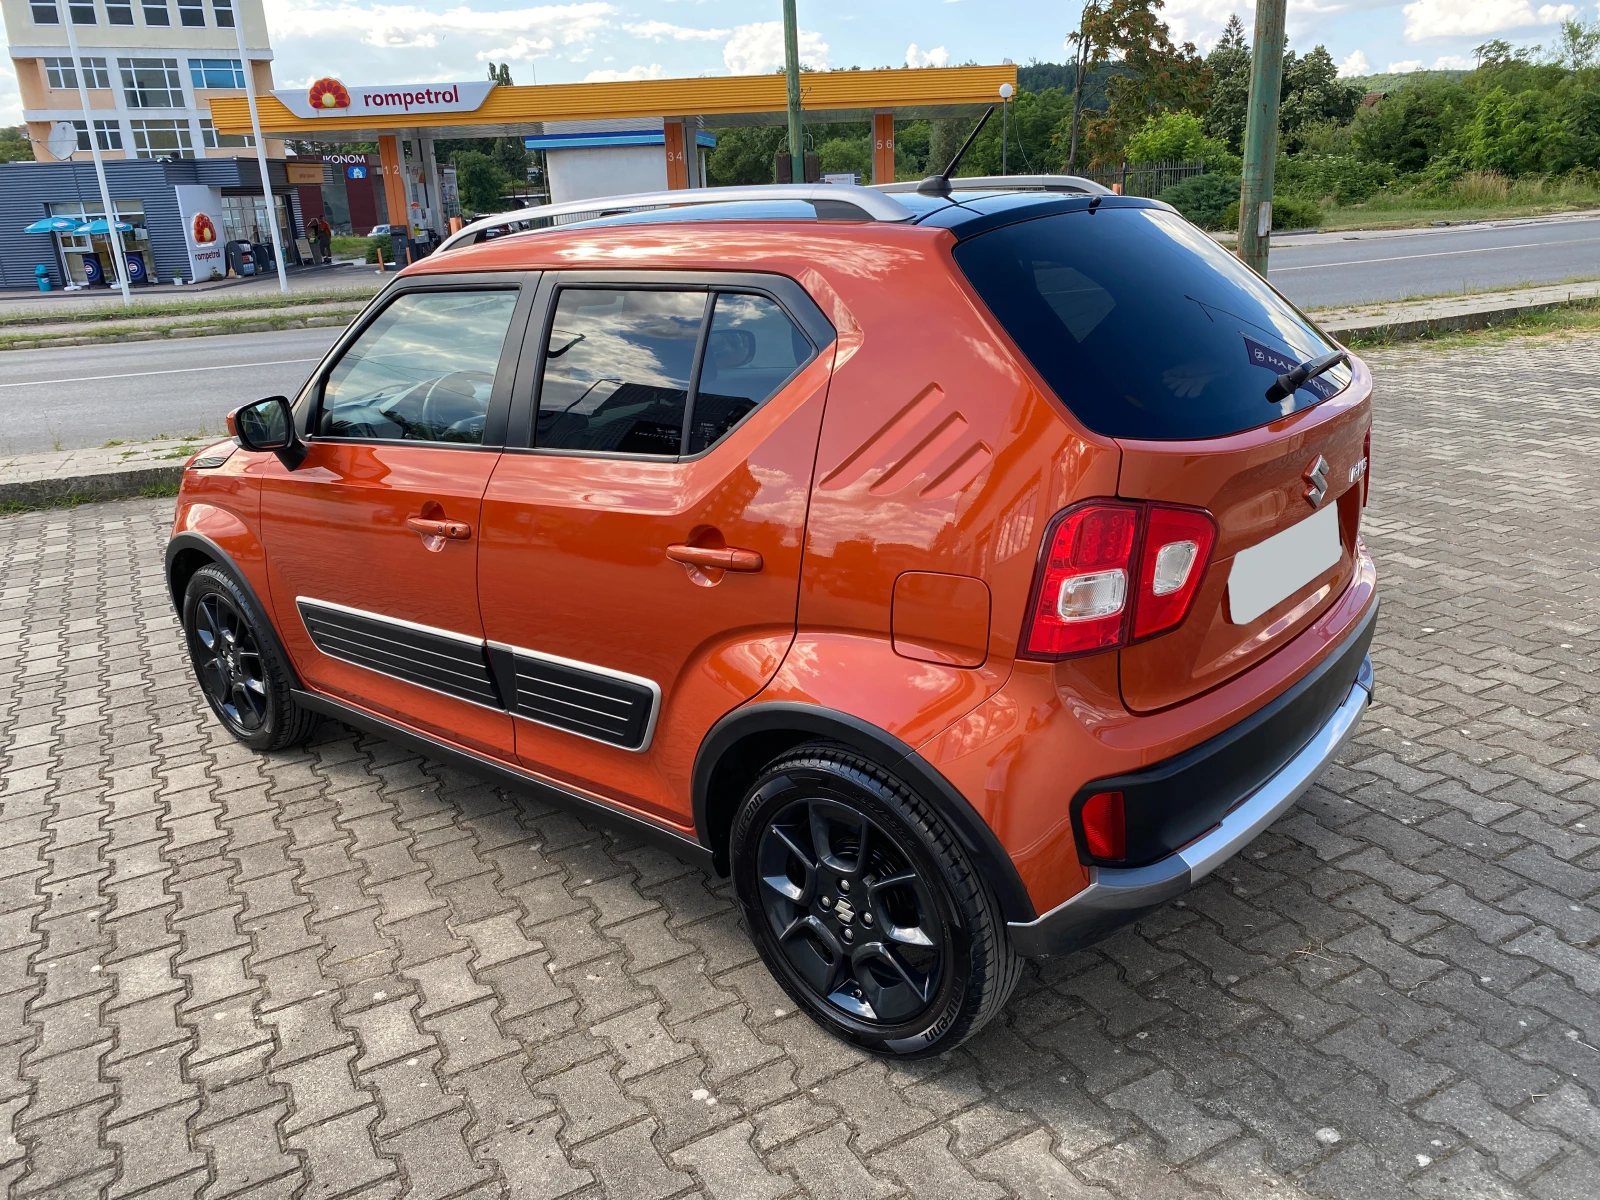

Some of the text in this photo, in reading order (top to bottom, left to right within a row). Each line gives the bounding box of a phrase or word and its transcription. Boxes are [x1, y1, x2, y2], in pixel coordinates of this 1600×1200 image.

[364, 84, 459, 111] rompetrol
[877, 139, 893, 150] 5 6
[668, 151, 683, 161] 3 4
[384, 165, 399, 175] 1 2
[195, 249, 220, 262] rompetrol
